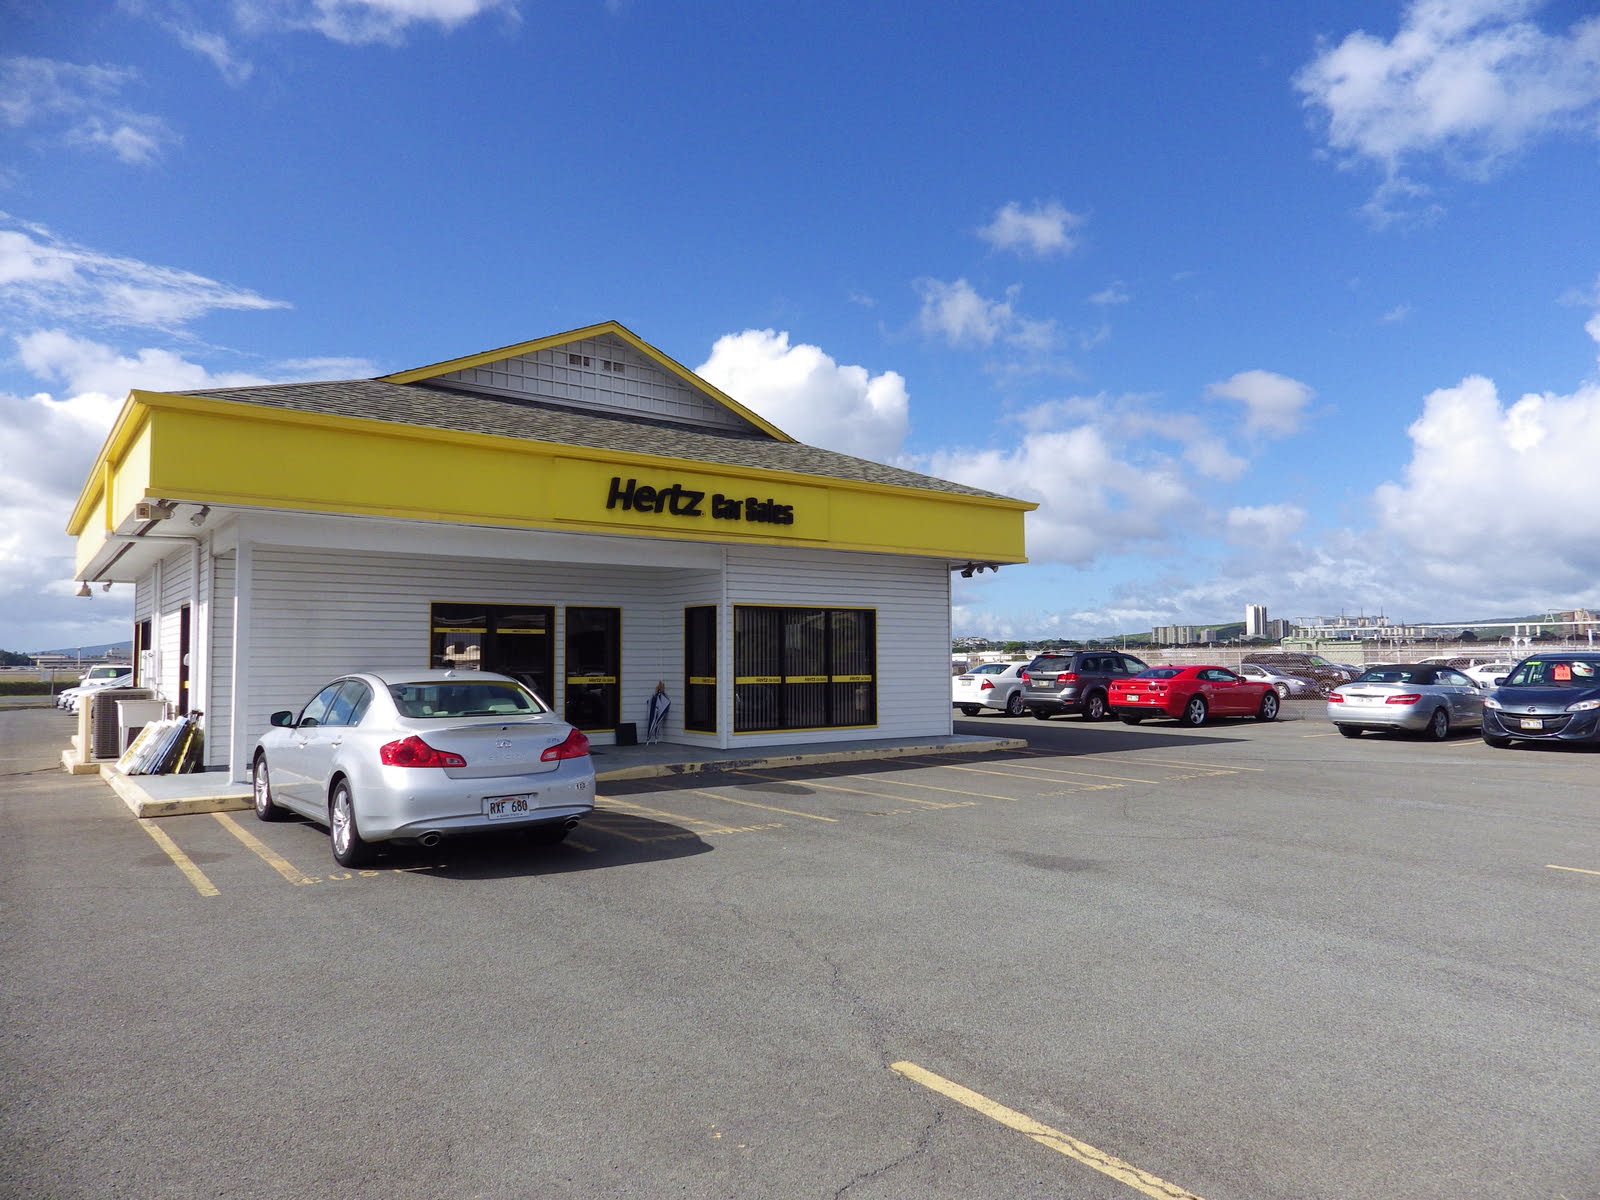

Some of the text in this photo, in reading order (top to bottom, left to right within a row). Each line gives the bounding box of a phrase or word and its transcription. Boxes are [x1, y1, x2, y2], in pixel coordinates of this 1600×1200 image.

[606, 477, 794, 525] Hertz Car Sales
[490, 800, 528, 814] RXF 680
